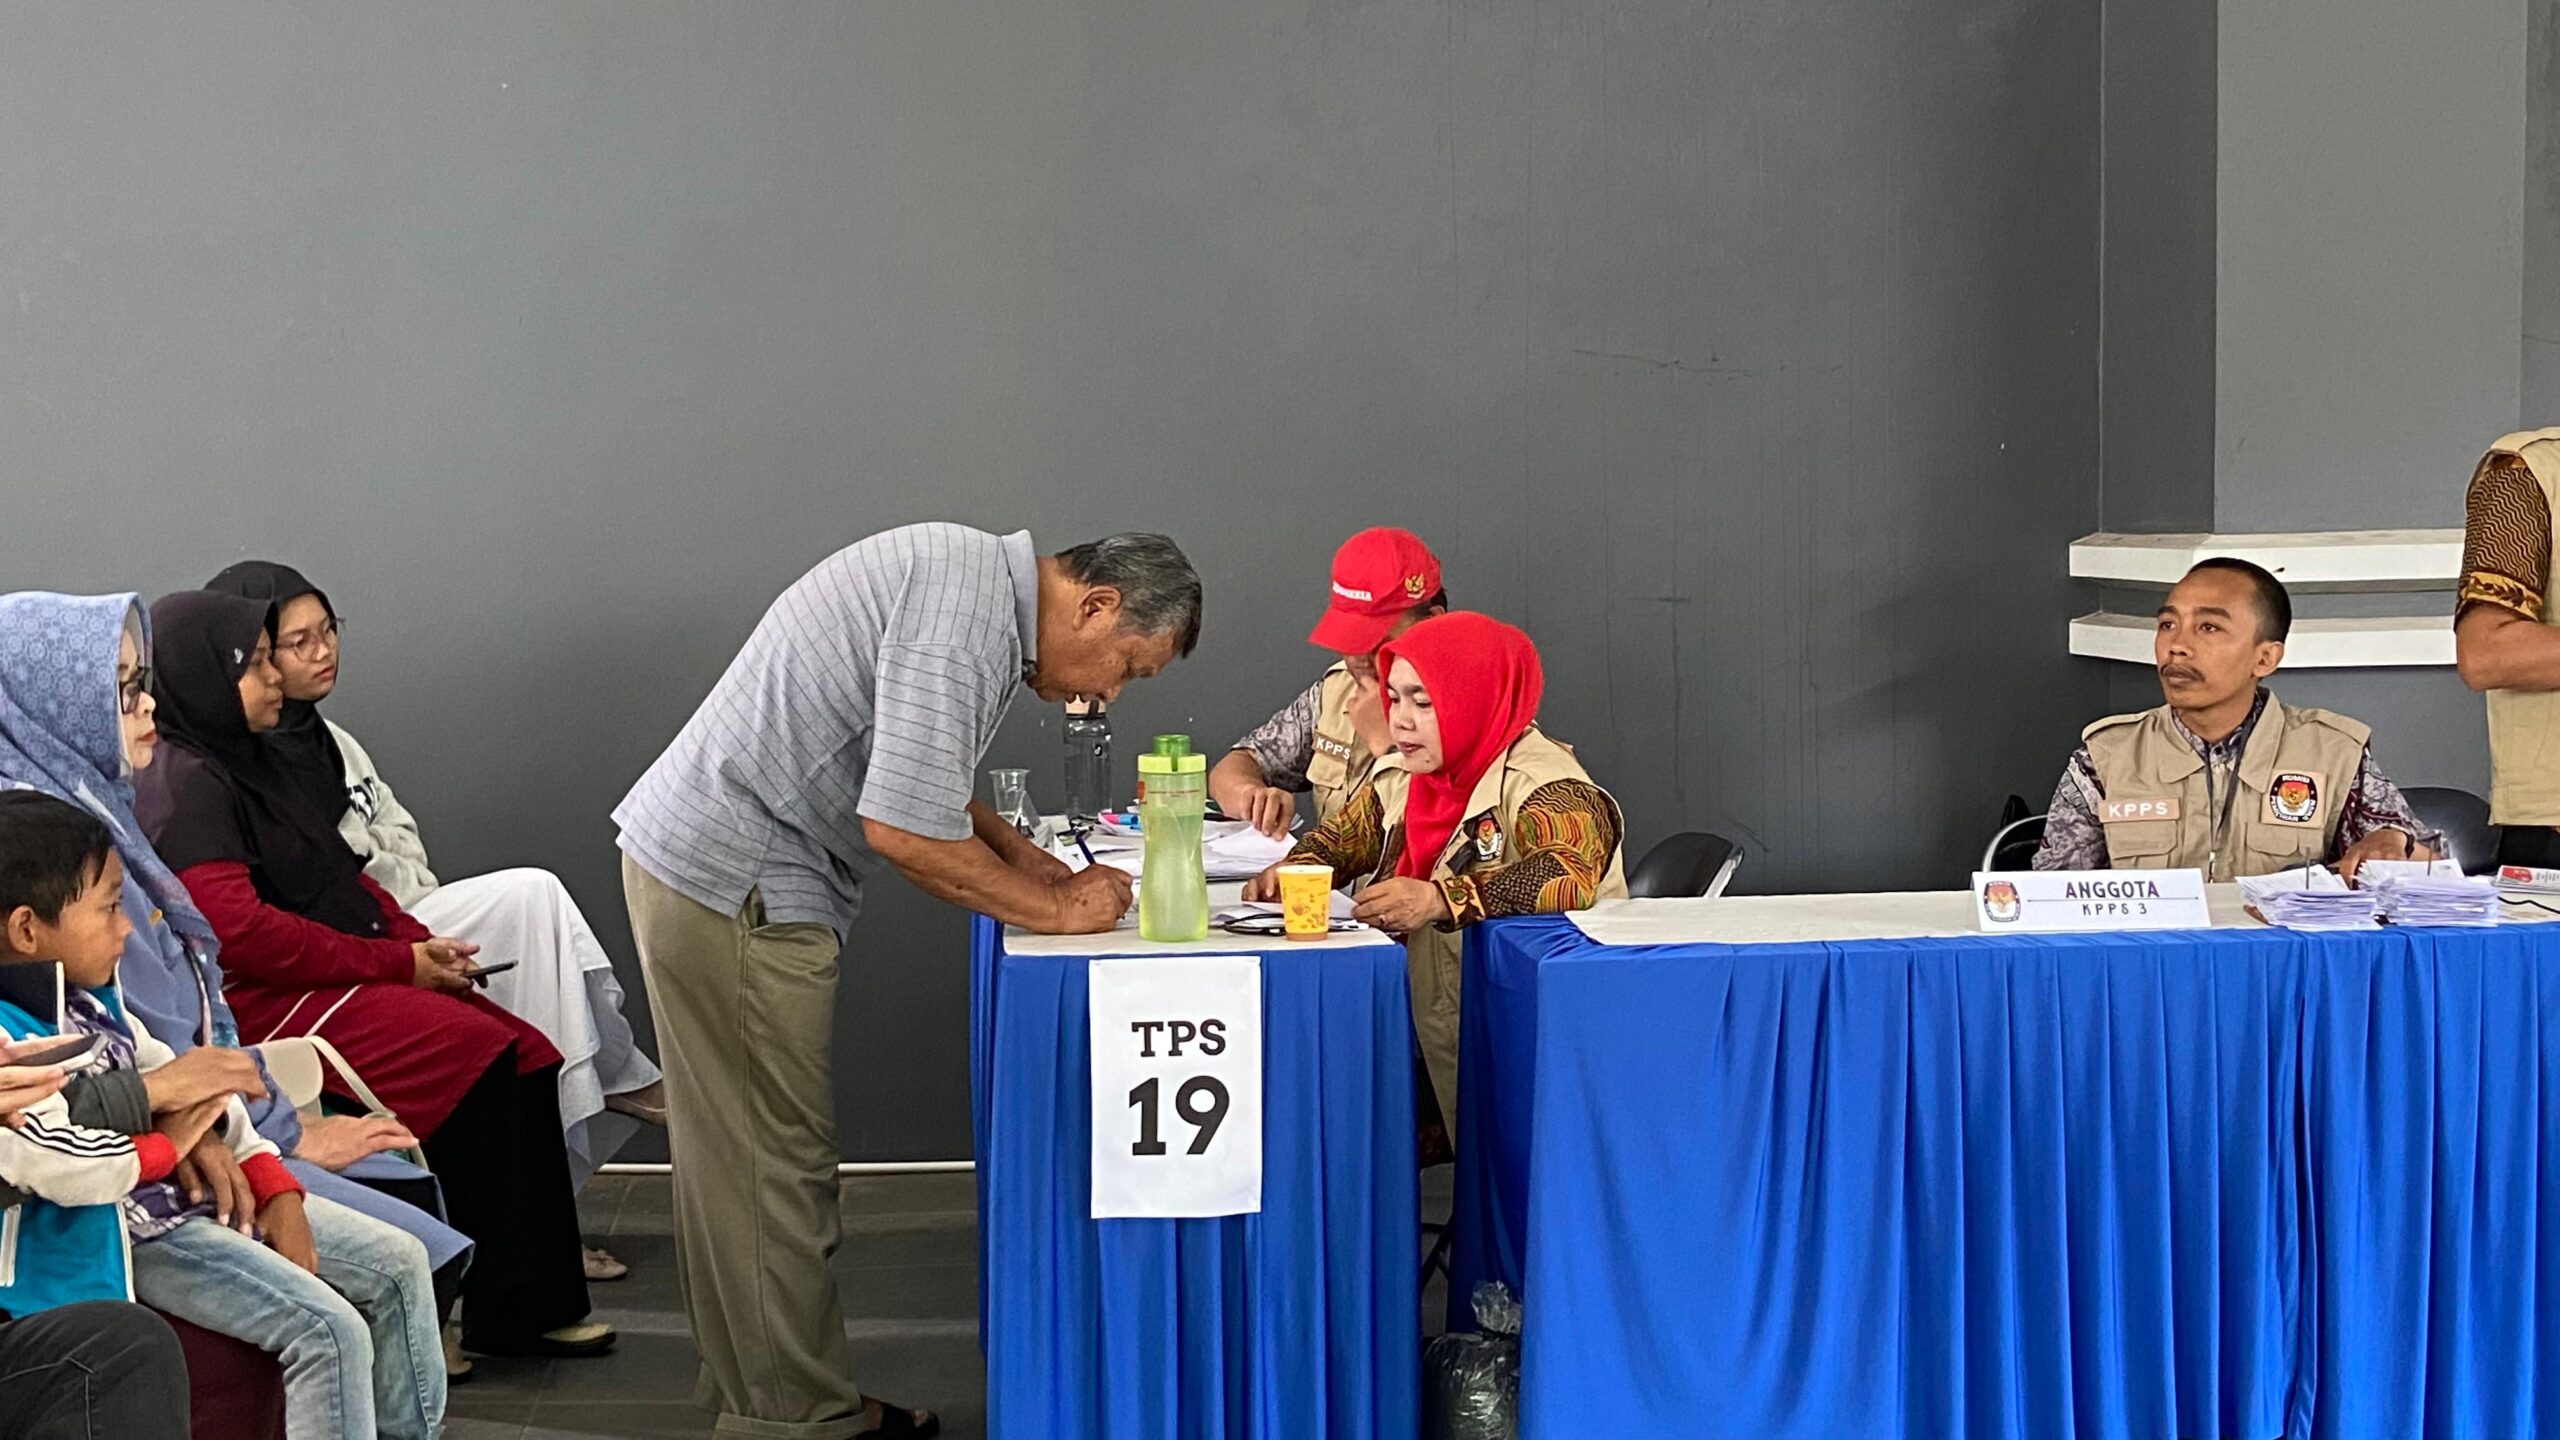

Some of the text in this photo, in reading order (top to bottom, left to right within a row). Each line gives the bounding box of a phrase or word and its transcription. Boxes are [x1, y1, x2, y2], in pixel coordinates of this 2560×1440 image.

[1316, 737, 1351, 760] KPPS
[2108, 802, 2169, 818] KPPS
[2065, 880, 2160, 899] ANGGOTA
[2082, 903, 2148, 916] KPPS 3
[1131, 1018, 1227, 1058] TPS
[1128, 1075, 1230, 1156] 19
